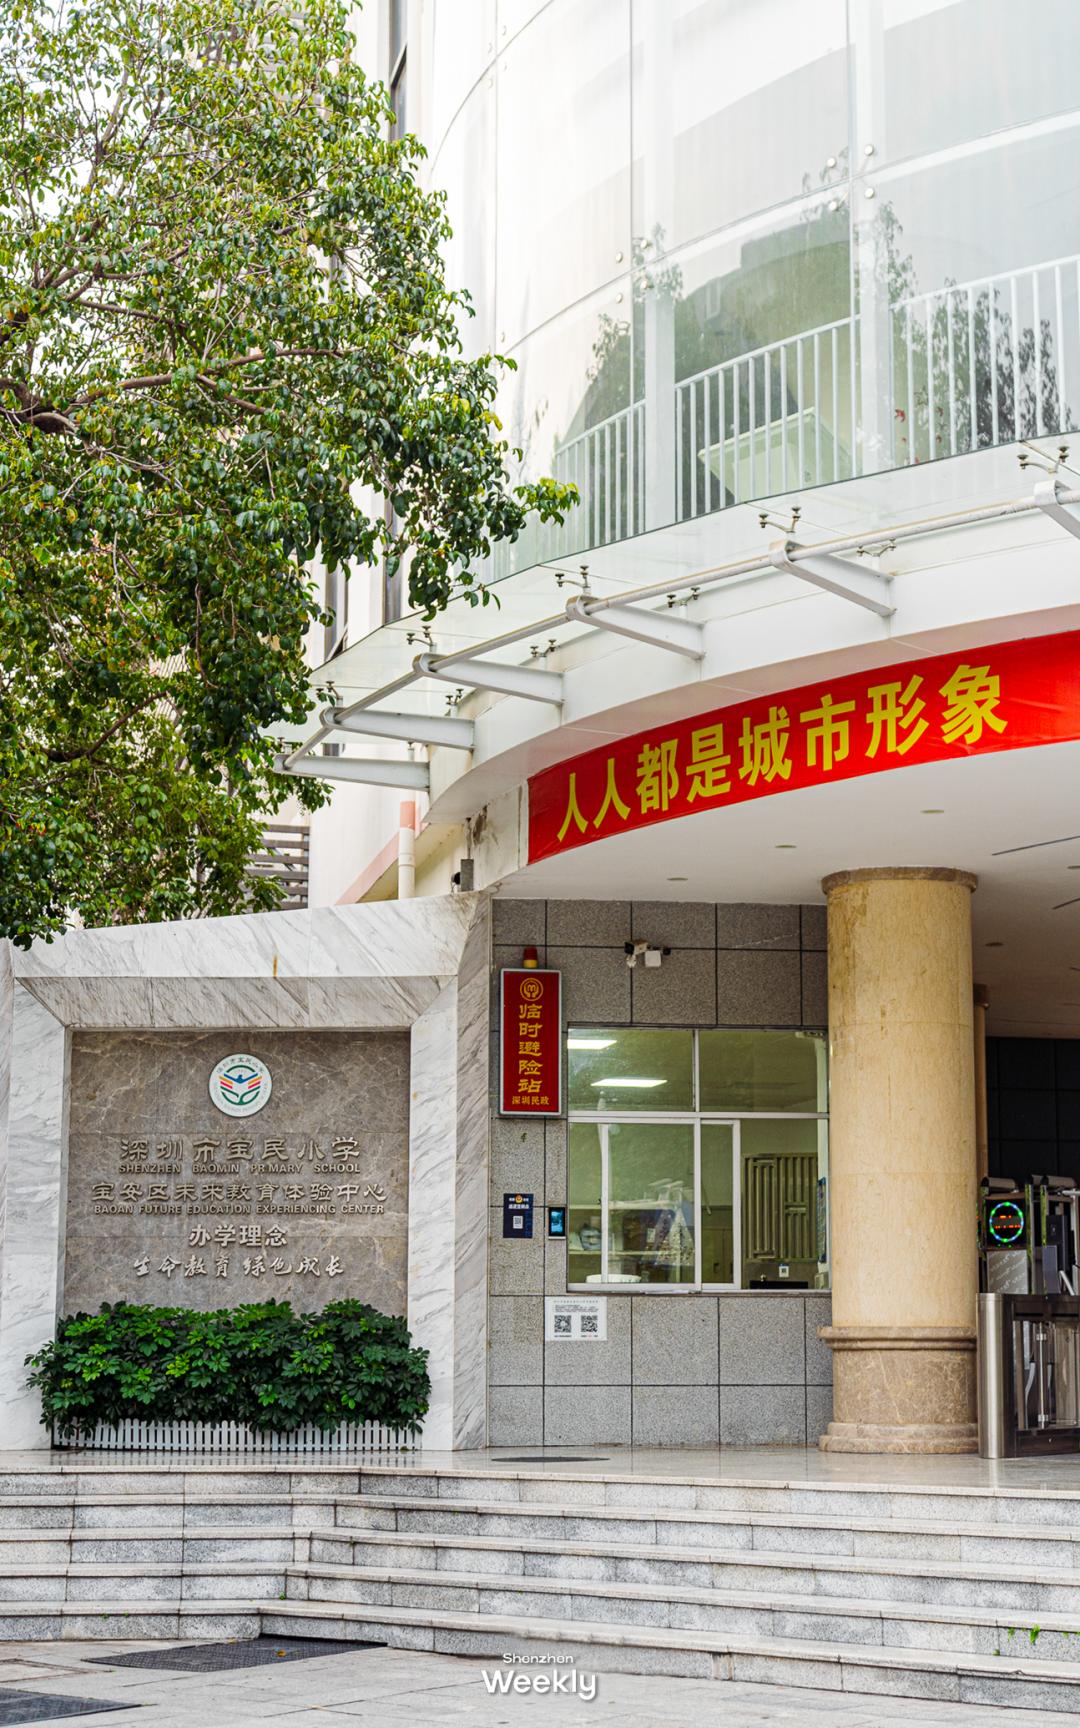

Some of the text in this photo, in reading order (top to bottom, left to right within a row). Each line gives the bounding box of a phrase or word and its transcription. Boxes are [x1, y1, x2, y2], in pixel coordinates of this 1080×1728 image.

[556, 663, 1009, 842] 人人都是城市形象
[518, 1003, 543, 1094] 临时避险站
[511, 1095, 550, 1106] 深圳民政
[120, 1136, 361, 1162] 深圳市宝民小学
[119, 1163, 361, 1174] SHENZHEN BAOMIN PRMARY SCHOOL
[91, 1181, 388, 1202] 宝安区未来教育体验中心
[94, 1204, 385, 1215] BAOAN FUTURE EDUCATION EXPERIENCING CENTER
[188, 1223, 289, 1248] 办学理念
[133, 1254, 345, 1278] 生命教育 绿色成长
